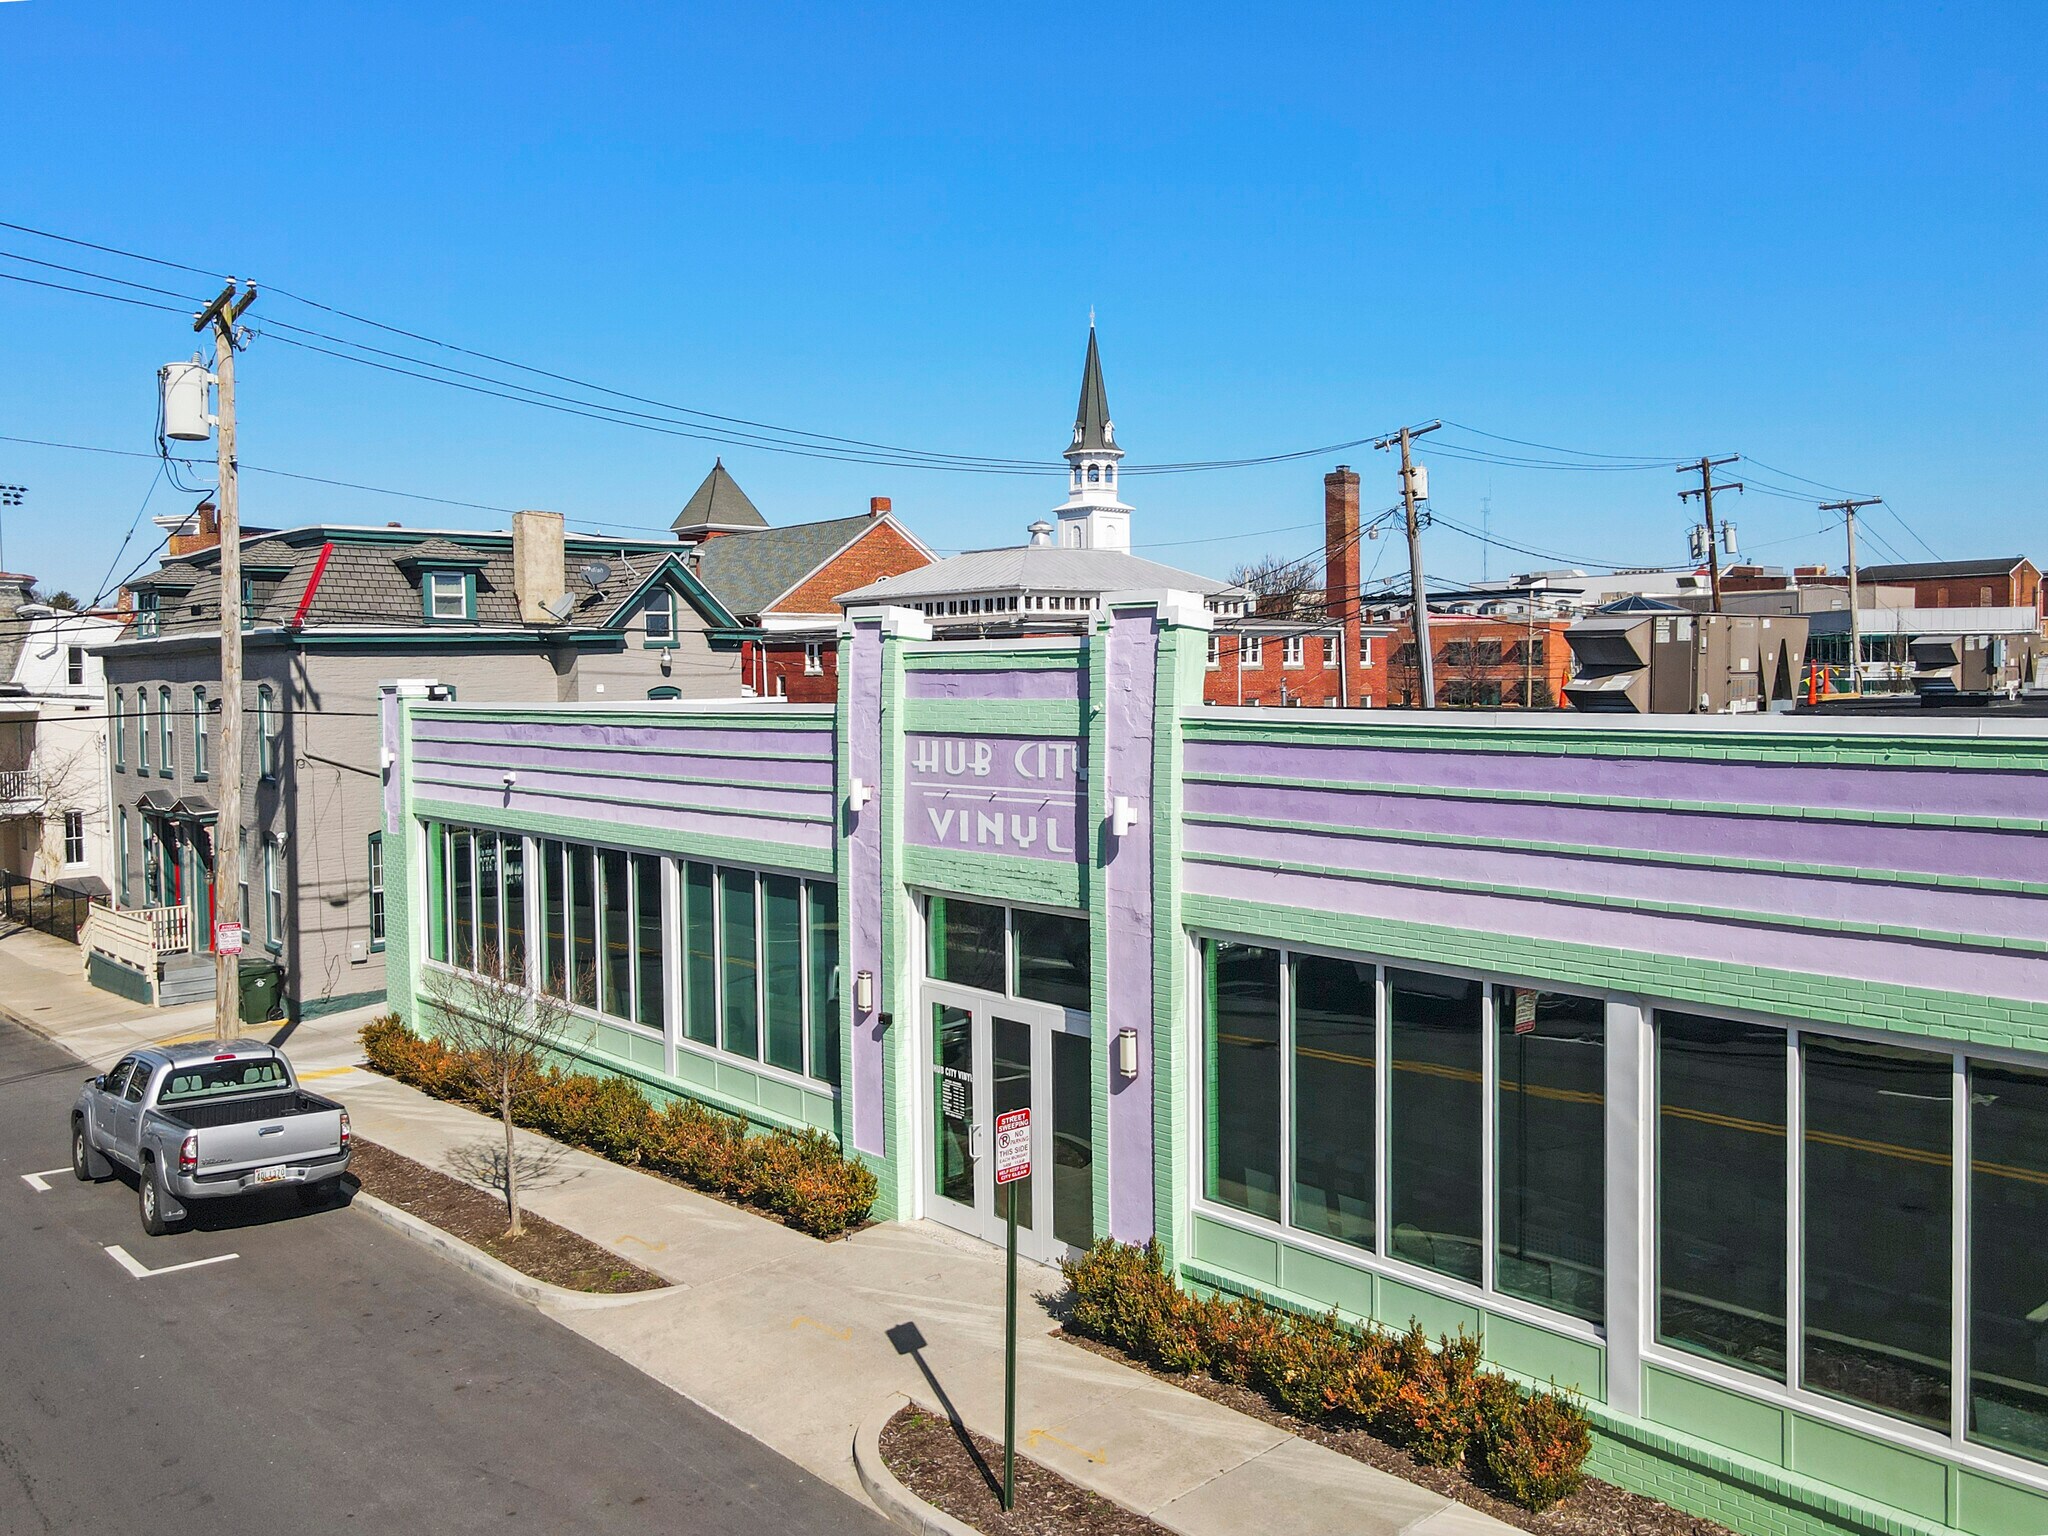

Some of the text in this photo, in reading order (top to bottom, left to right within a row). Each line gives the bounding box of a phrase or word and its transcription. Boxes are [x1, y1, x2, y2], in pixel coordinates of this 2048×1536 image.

[911, 740, 1089, 781] HUB CITY
[927, 807, 1074, 853] VINYL
[944, 1067, 957, 1079] CITY
[998, 1118, 1029, 1132] SWEEPING
[1001, 1113, 1026, 1124] STREET
[1014, 1129, 1024, 1138] NO
[1010, 1136, 1029, 1145] PARKING
[999, 1144, 1028, 1158] THIS SIDE
